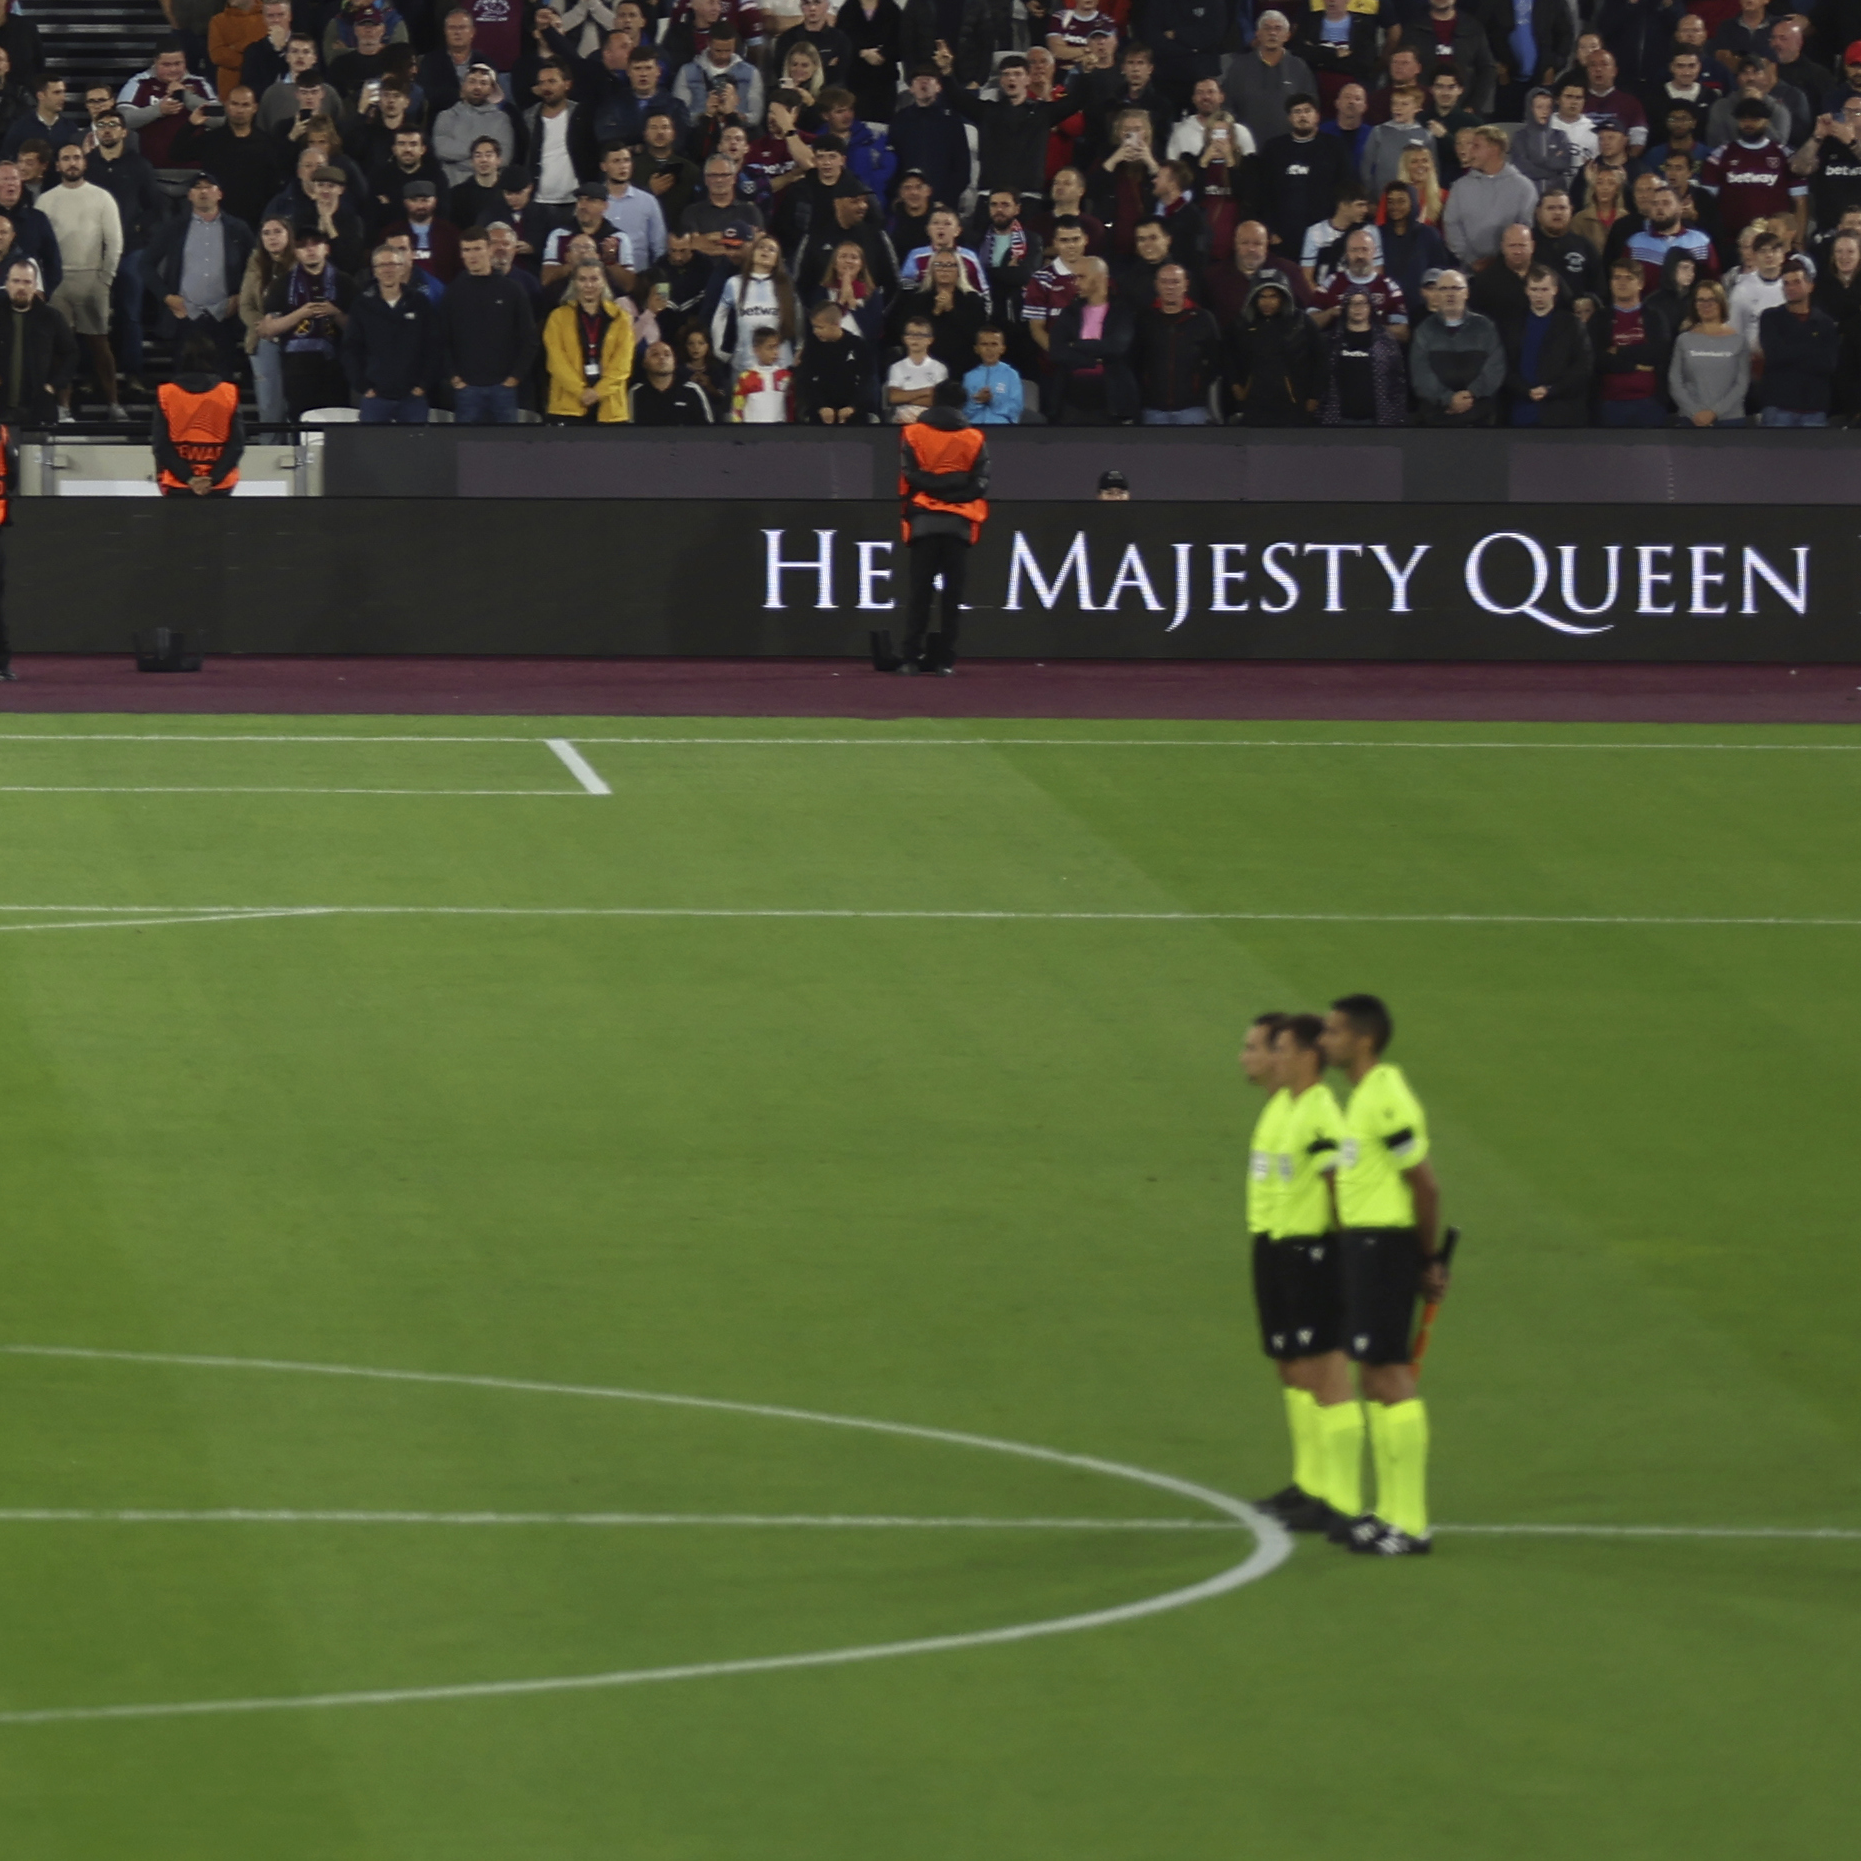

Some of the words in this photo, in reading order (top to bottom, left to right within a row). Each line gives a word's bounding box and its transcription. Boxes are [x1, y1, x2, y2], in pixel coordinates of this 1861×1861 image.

[1727, 170, 1776, 187] betway
[761, 529, 972, 609] HE
[1002, 530, 1429, 630] MAJESTY
[1466, 533, 1809, 634] QUEEN
